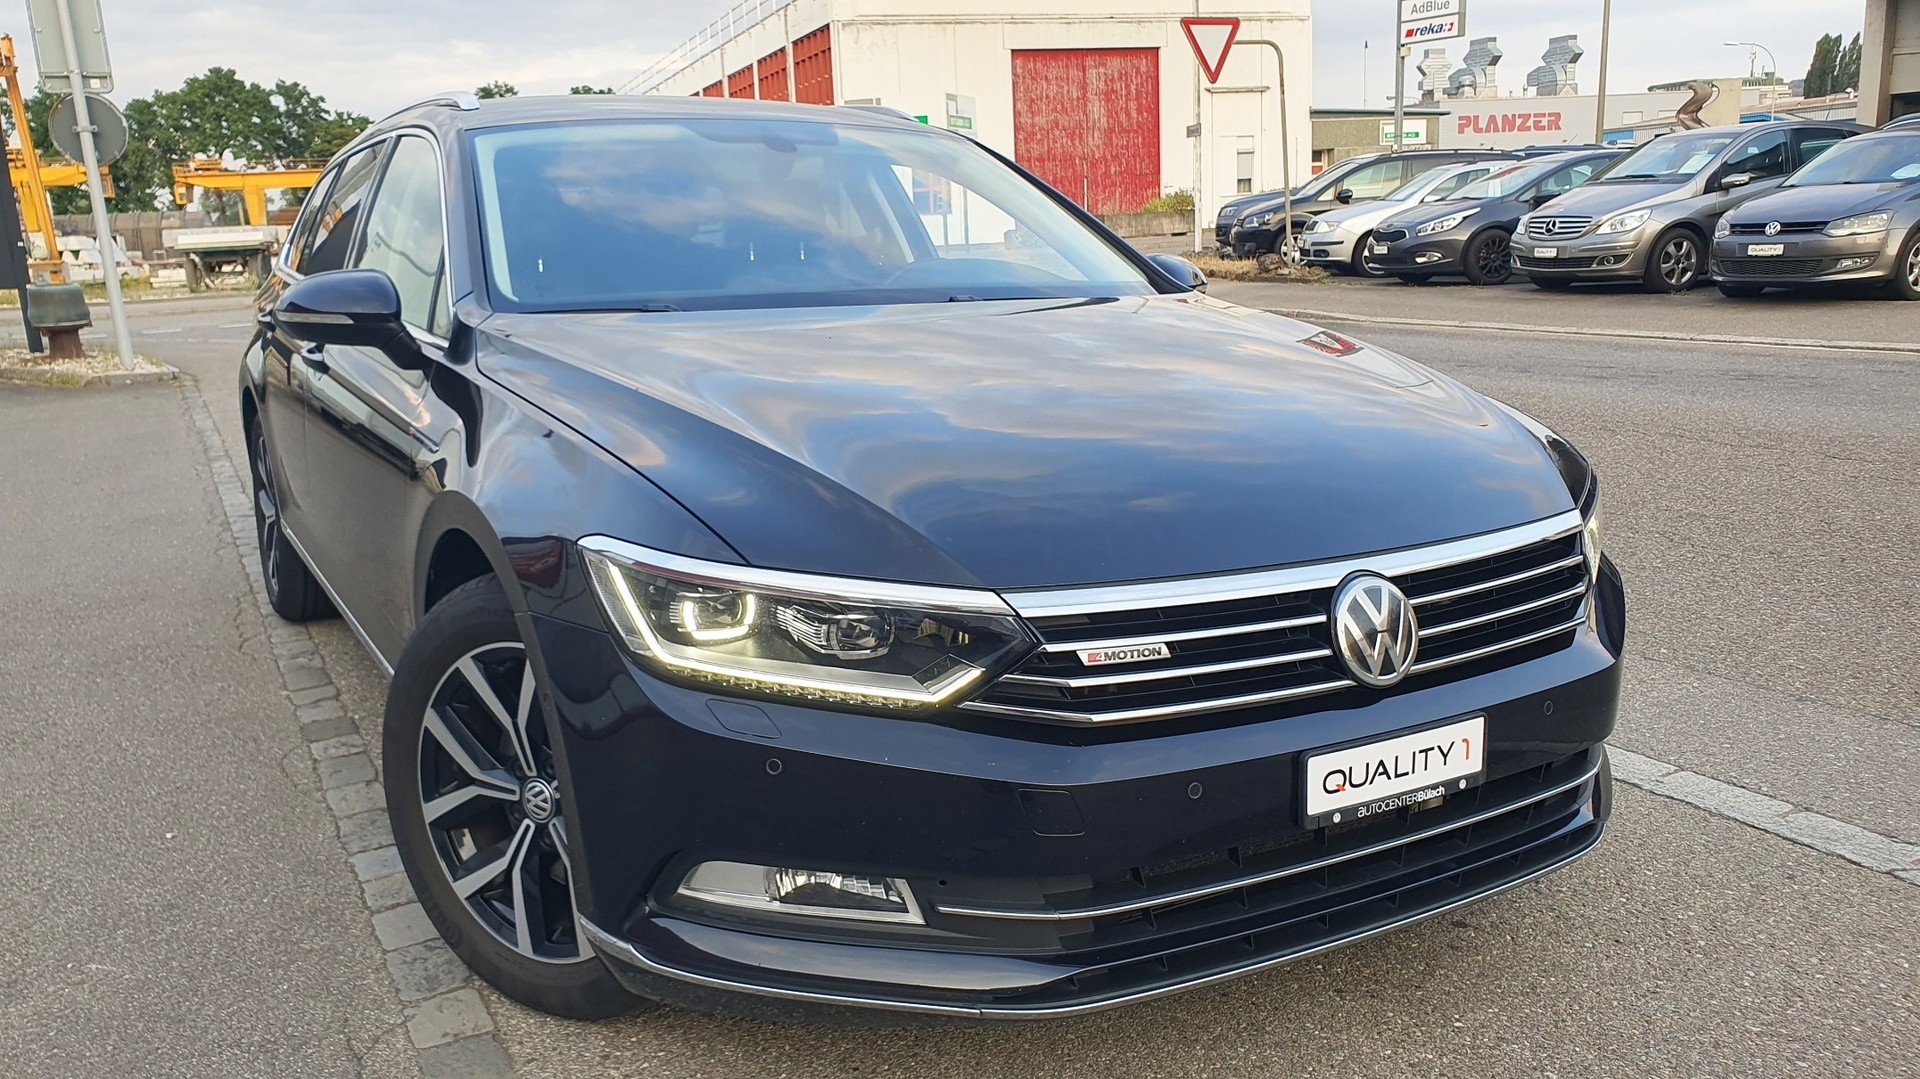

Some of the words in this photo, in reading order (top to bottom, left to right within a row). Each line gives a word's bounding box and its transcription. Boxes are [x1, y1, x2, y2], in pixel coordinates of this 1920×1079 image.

[1411, 0, 1450, 15] AdBlue
[1458, 112, 1561, 134] PLANZER
[1088, 647, 1162, 662] 4MOTION
[1322, 741, 1455, 795] QUALITY
[1461, 738, 1470, 760] 1
